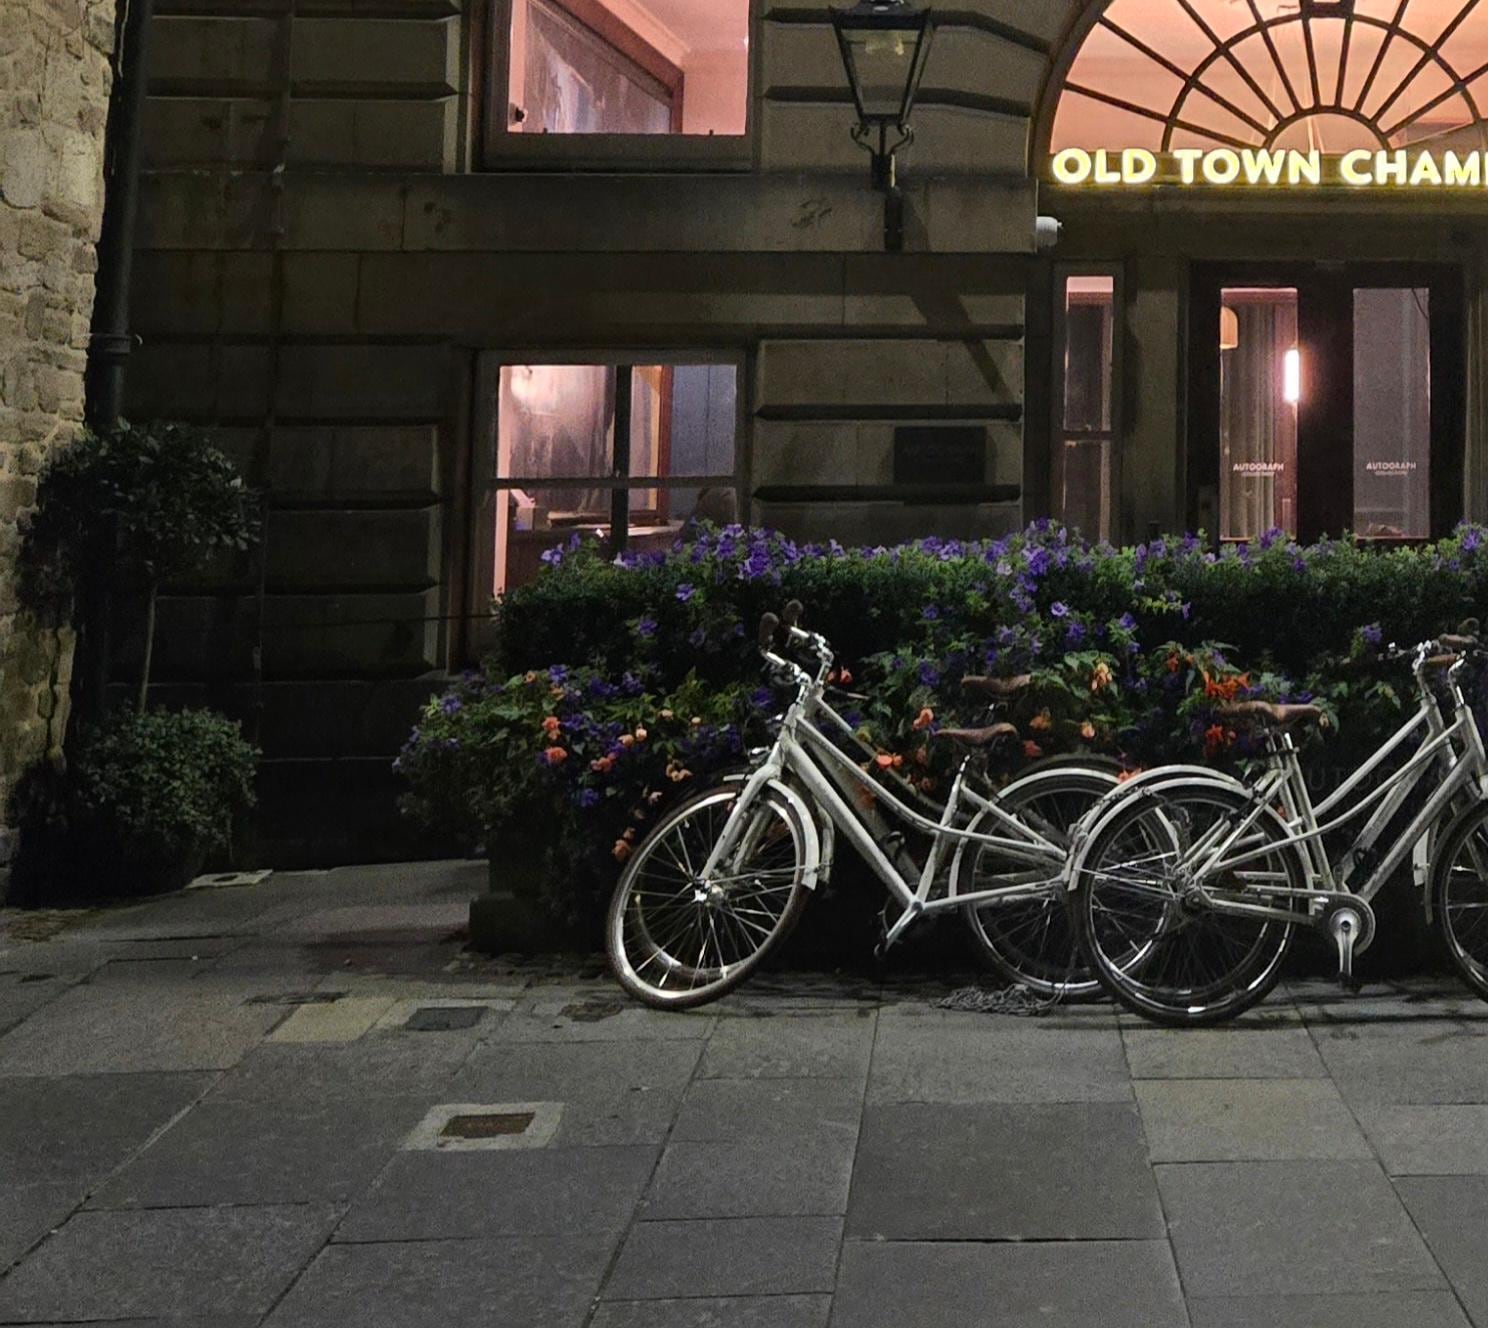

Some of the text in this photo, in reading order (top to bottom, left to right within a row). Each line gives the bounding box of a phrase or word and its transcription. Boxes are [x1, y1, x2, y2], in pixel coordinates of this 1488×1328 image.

[1052, 147, 1157, 184] OLD
[1172, 148, 1322, 185] TOWN
[1233, 462, 1284, 472] AUTOGRAPH
[1366, 461, 1417, 471] AUTOGRAPH
